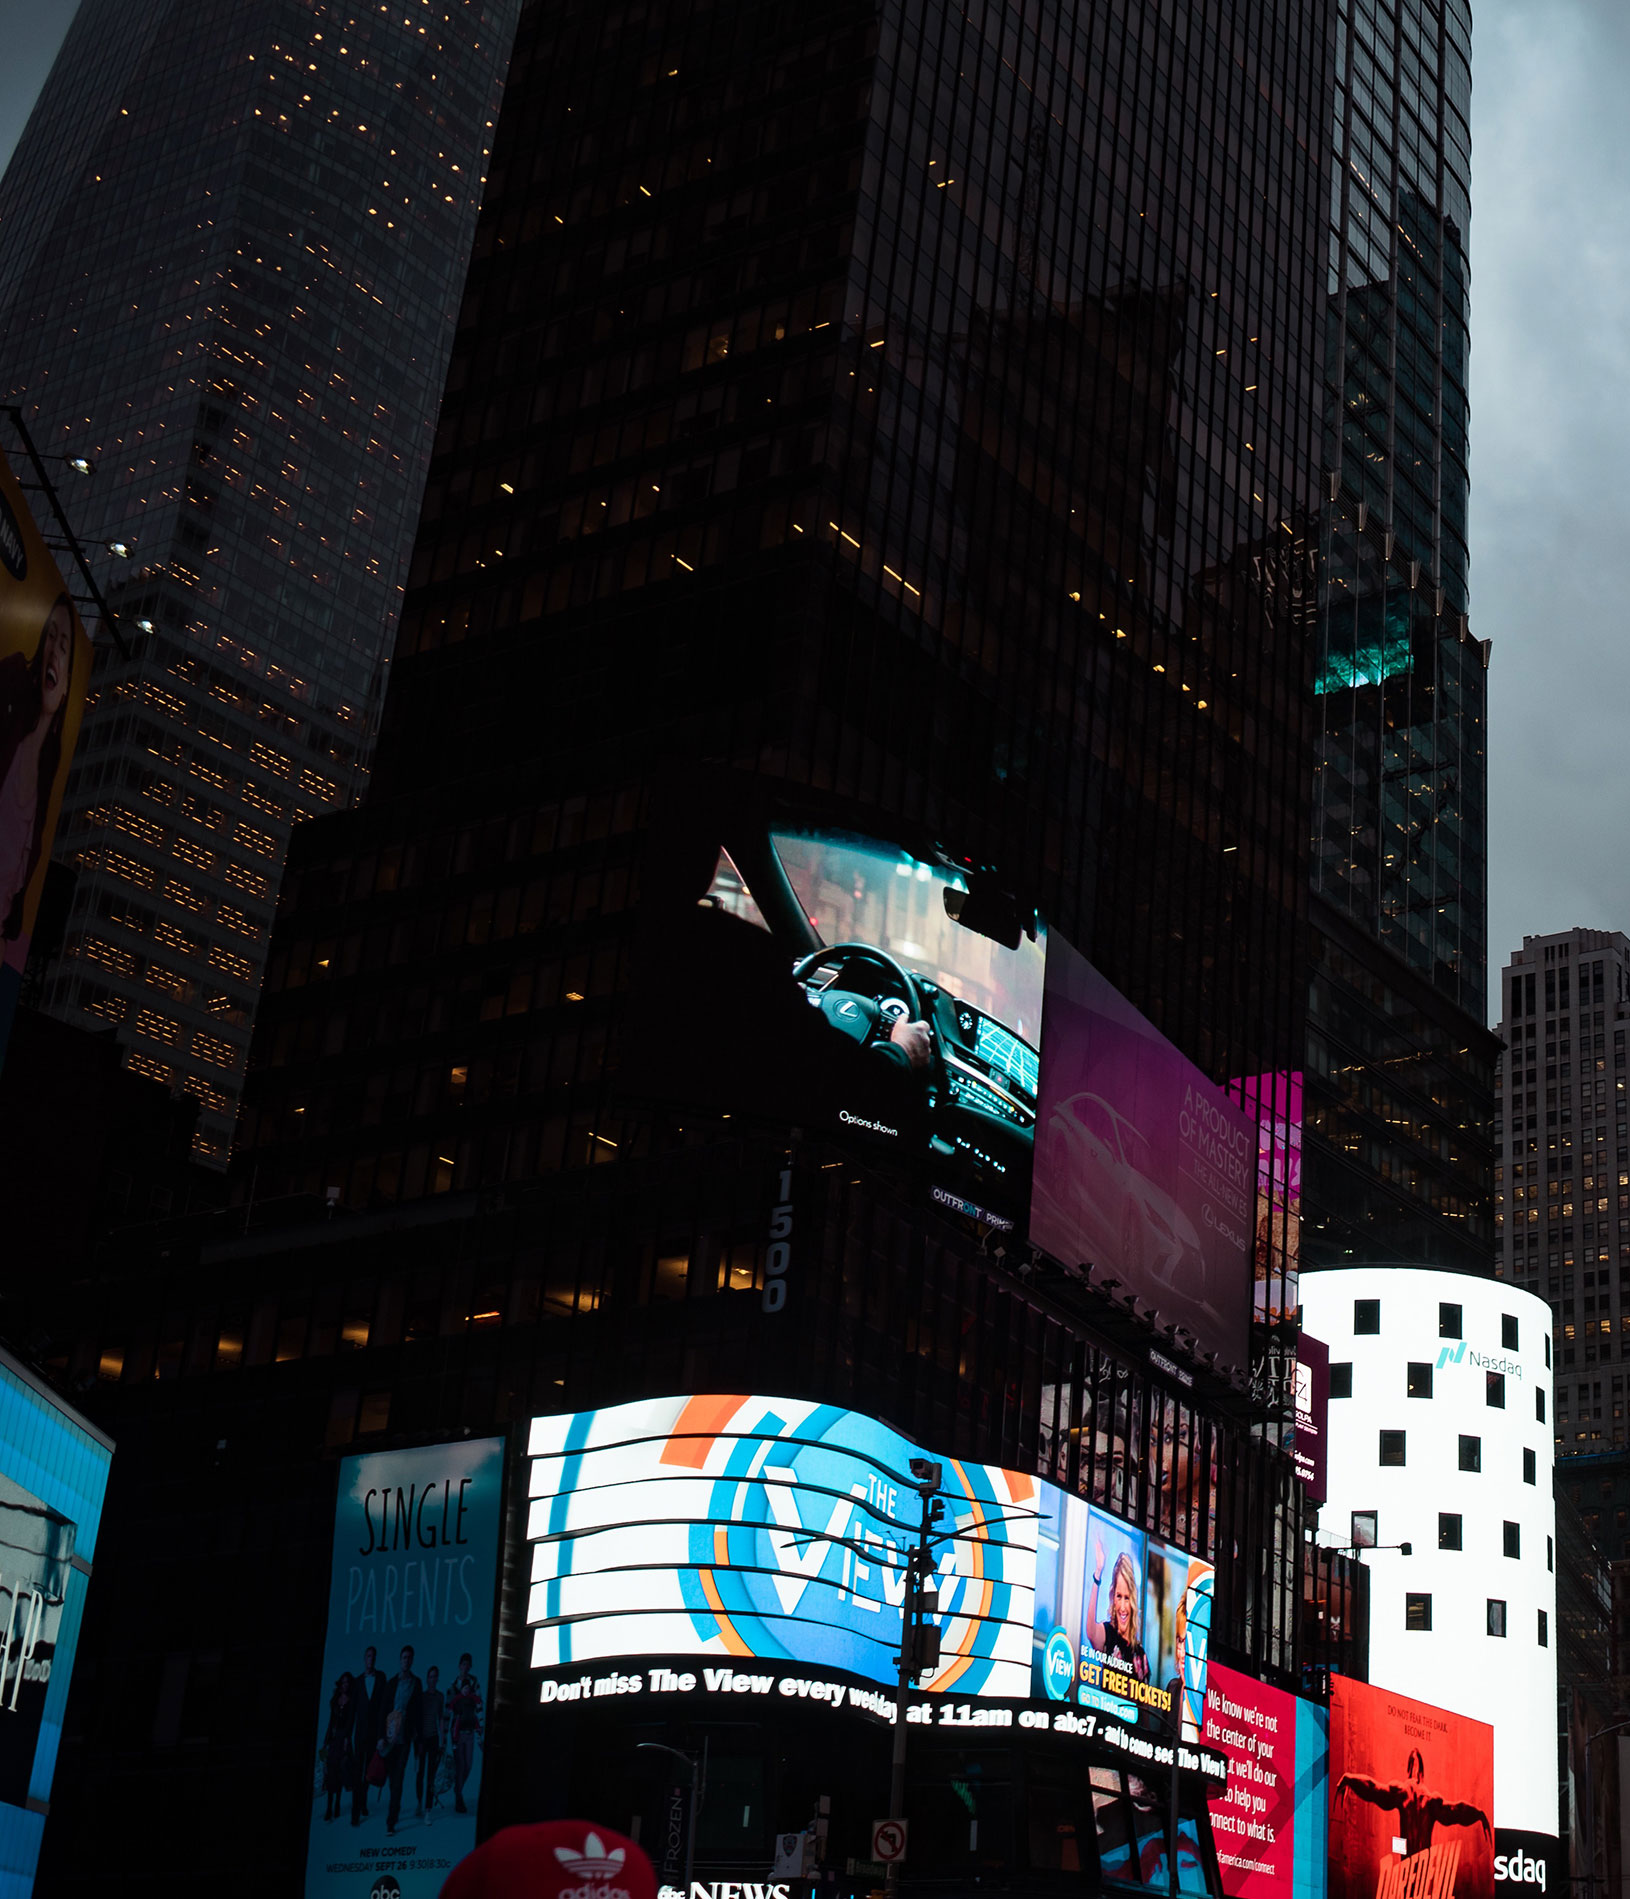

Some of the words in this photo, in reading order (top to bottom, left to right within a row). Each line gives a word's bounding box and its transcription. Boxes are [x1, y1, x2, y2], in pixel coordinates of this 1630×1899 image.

[839, 1110, 872, 1129] Options
[873, 1120, 898, 1136] shown
[1184, 1083, 1192, 1110] A
[1196, 1092, 1250, 1161] PRODUCT
[1179, 1110, 1196, 1142] OF
[1199, 1127, 1248, 1189] MASTERY
[1194, 1159, 1207, 1182] THE
[933, 1188, 983, 1219] OUTFRONT
[761, 1170, 793, 1313] 1500
[1214, 1216, 1246, 1252] LEXUS
[1470, 1351, 1522, 1380] Nasdaq
[868, 1473, 897, 1519] THE
[359, 1478, 472, 1555] SINGLE
[345, 1555, 475, 1634] PARENTS
[1080, 1662, 1102, 1685] GET
[1102, 1668, 1128, 1696] FREE
[1129, 1678, 1172, 1712] TICKETS!
[540, 1677, 591, 1703] Don't
[594, 1672, 643, 1698] miss
[648, 1669, 696, 1692] The
[703, 1669, 775, 1694] View
[779, 1674, 846, 1708] every
[906, 1704, 932, 1724] at
[938, 1704, 1012, 1728] 11am
[1018, 1708, 1049, 1730] on
[1054, 1711, 1097, 1737] abc7
[1129, 1736, 1154, 1759] come
[1177, 1748, 1199, 1770] The
[1208, 1689, 1220, 1711] We
[1221, 1693, 1243, 1720] know
[1244, 1705, 1264, 1728] we're
[1265, 1716, 1278, 1733] not
[1397, 1708, 1409, 1720] NOT
[1409, 1712, 1422, 1725] FEAR
[1422, 1715, 1433, 1728] THE
[1206, 1718, 1220, 1740] the
[1221, 1726, 1247, 1749] center
[1248, 1732, 1256, 1752] of
[1257, 1740, 1274, 1760] your
[1404, 1725, 1425, 1740] BECOME
[1236, 1758, 1252, 1781] we'll
[1254, 1763, 1263, 1784] do
[1264, 1772, 1277, 1788] our
[1234, 1785, 1251, 1812] help
[1252, 1796, 1266, 1814] you
[664, 1796, 683, 1872] FROZEN
[1237, 1819, 1246, 1836] to
[1247, 1819, 1266, 1841] what
[1266, 1823, 1276, 1843] is.
[326, 1862, 375, 1874] WEDNESDAY
[375, 1861, 396, 1872] SEPT
[397, 1860, 407, 1872] 26
[360, 1848, 379, 1858] NEW
[382, 1846, 416, 1857] COMEDY
[1494, 1849, 1546, 1892] sdaq
[370, 1884, 400, 1899] abc
[558, 1882, 630, 1899] adidas
[689, 1882, 790, 1899] NEWS
